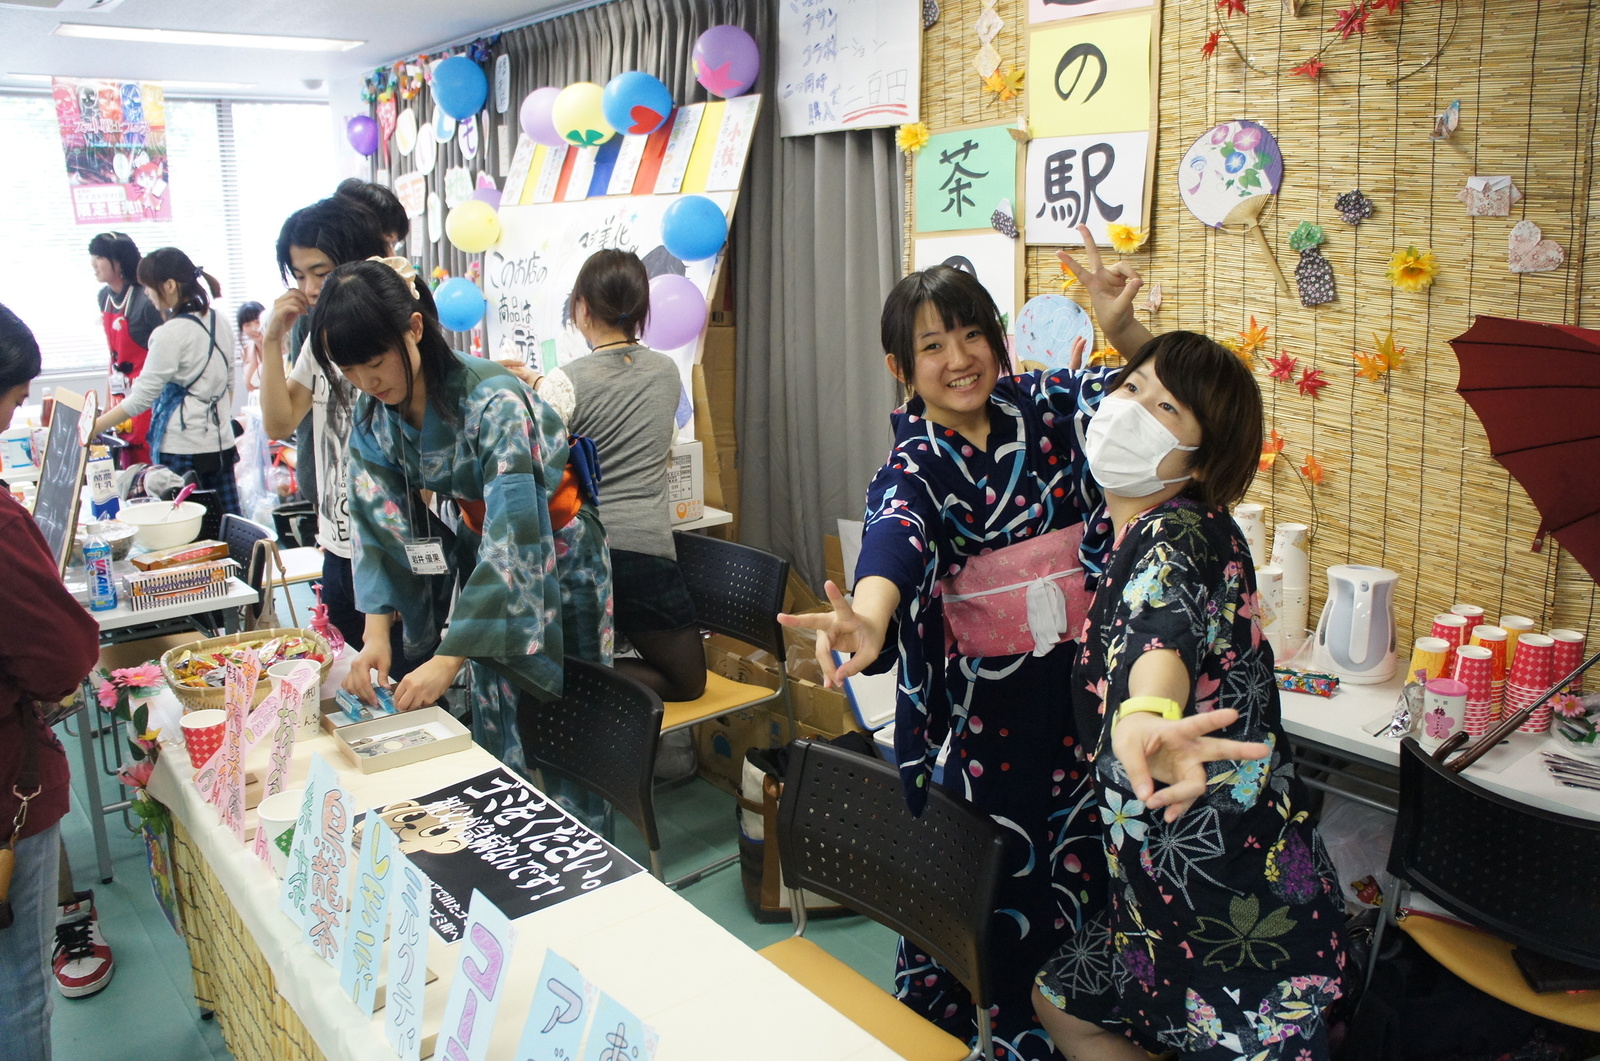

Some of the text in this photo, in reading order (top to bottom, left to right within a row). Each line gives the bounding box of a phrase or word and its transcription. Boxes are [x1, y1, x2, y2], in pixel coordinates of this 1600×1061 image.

[490, 250, 548, 289] このお店の
[498, 293, 532, 325] 商品は
[95, 558, 107, 597] VAAM
[463, 776, 614, 890] ゴミをください。
[393, 866, 423, 1059] ミルクティー
